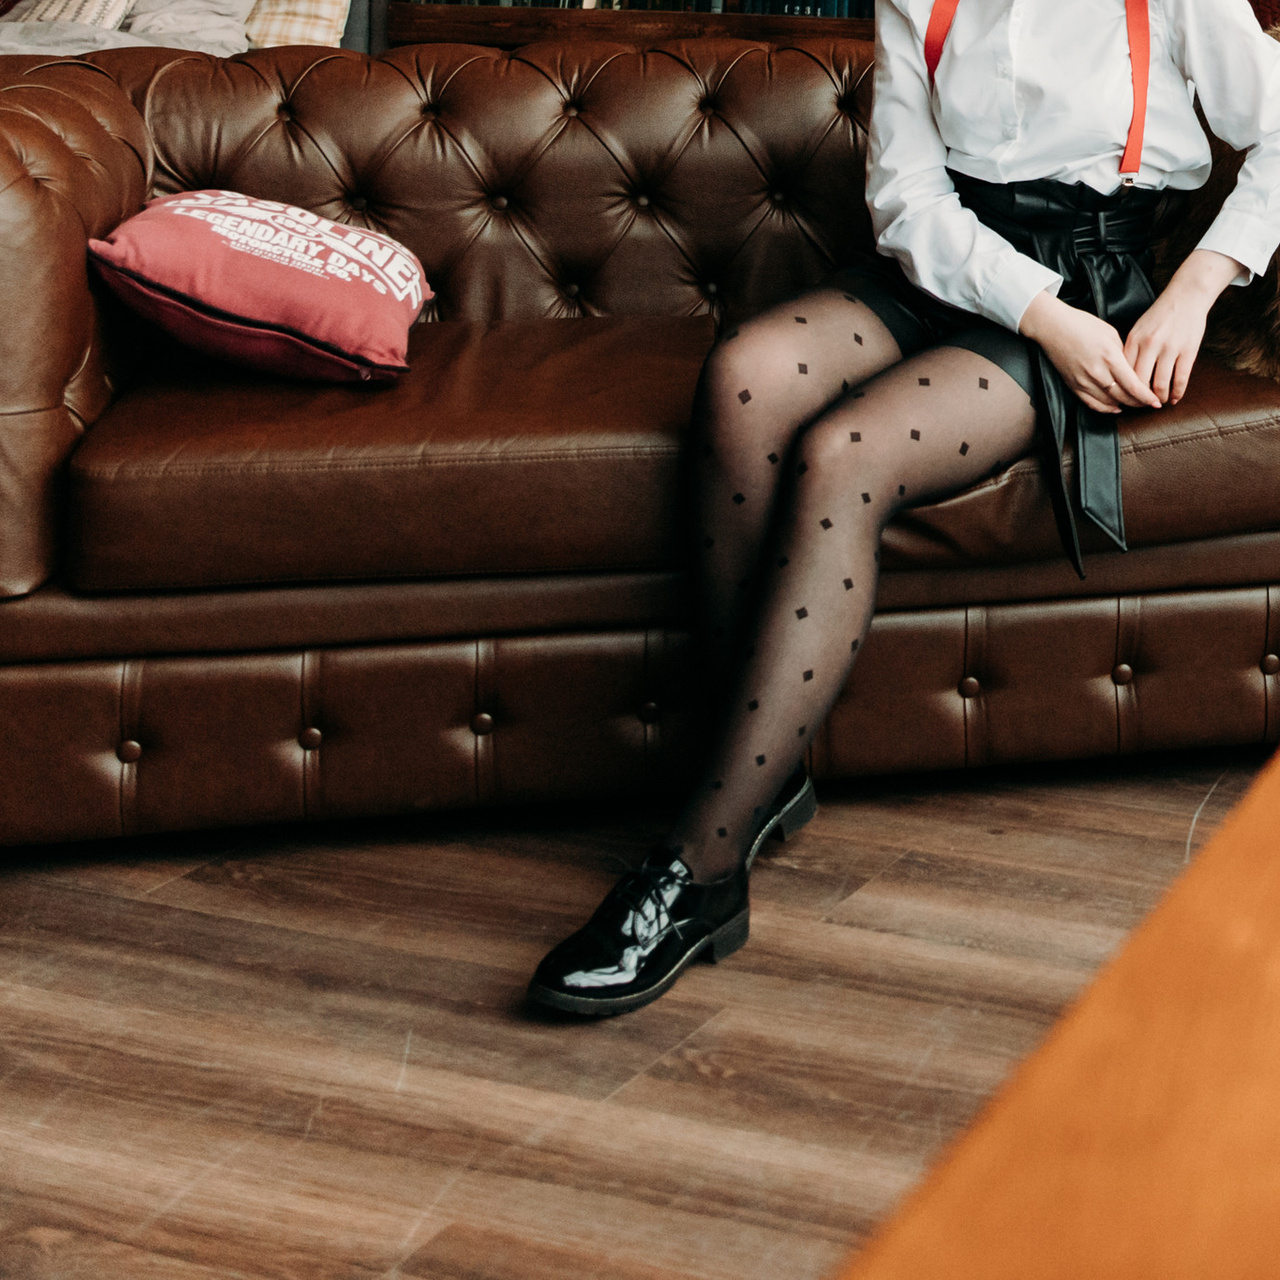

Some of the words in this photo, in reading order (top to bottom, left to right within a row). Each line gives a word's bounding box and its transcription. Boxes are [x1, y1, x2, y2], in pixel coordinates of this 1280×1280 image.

[173, 207, 325, 256] LEGENDARY
[327, 251, 387, 295] DAYS
[211, 224, 325, 268] MOTORCYCLE
[326, 265, 352, 282] CO.
